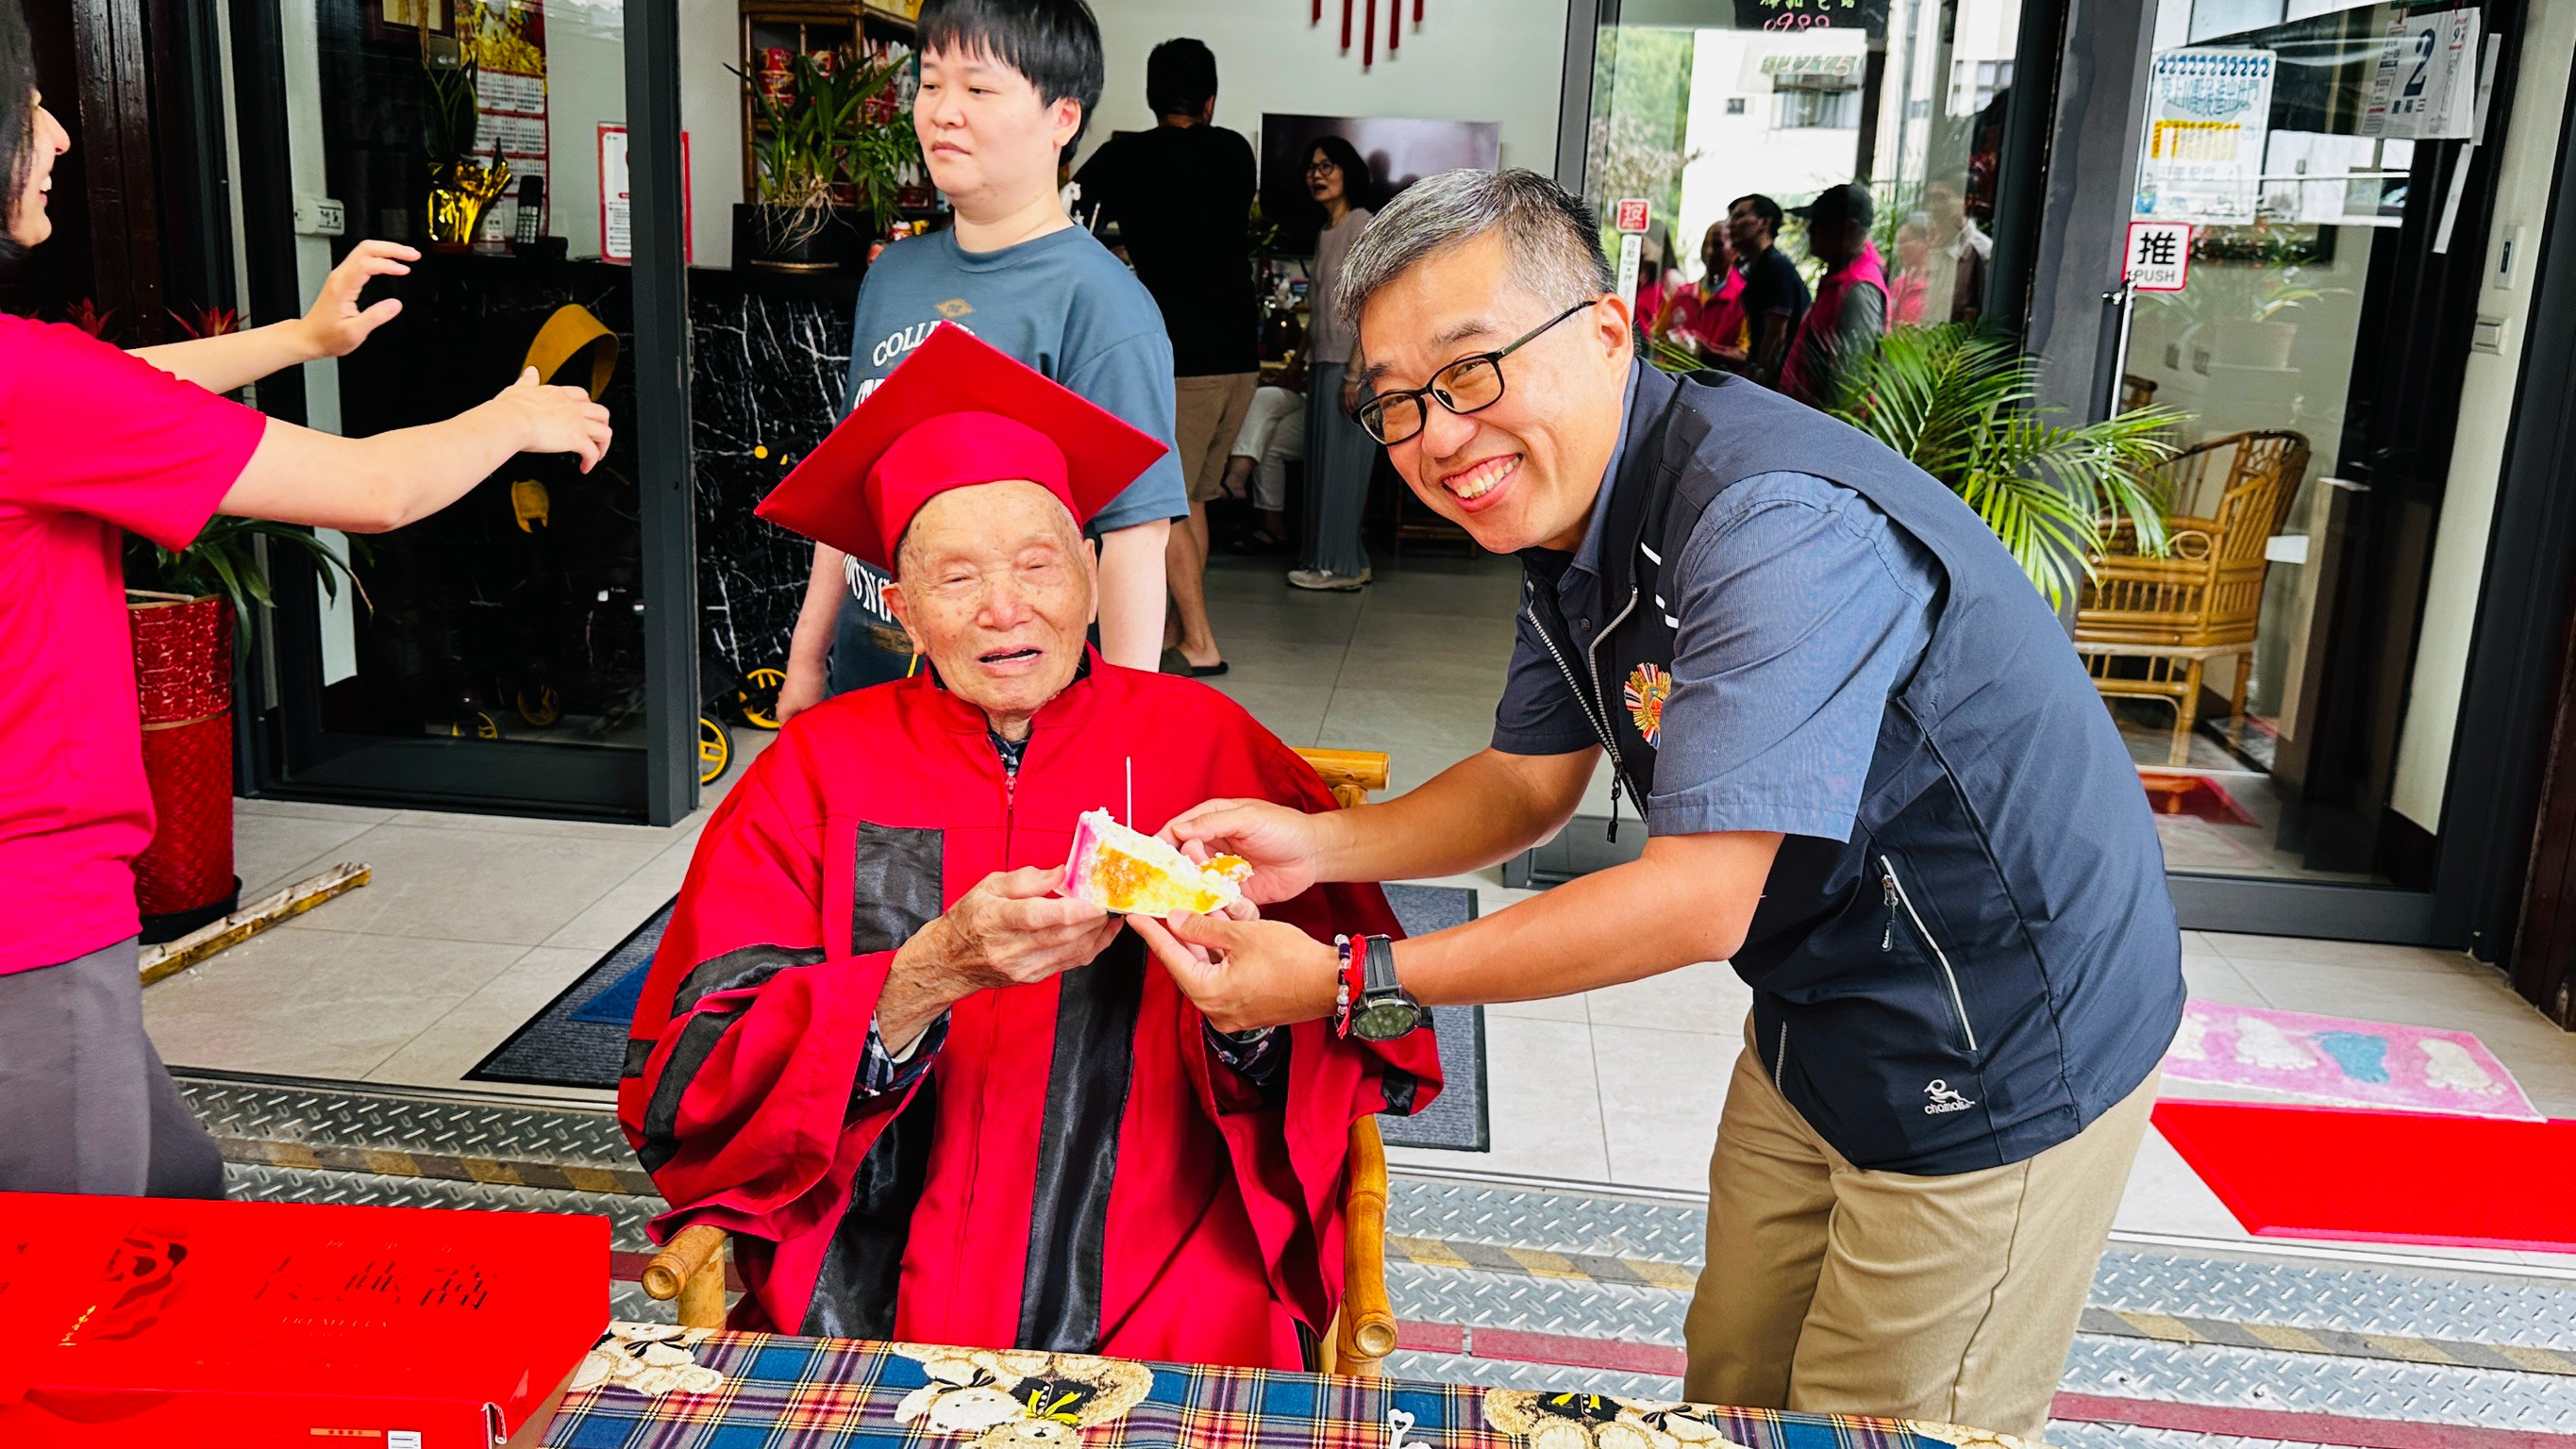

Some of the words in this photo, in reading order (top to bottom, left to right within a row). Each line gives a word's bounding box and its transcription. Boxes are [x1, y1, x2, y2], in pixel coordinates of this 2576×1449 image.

[2402, 27, 2436, 97] 2
[2137, 231, 2177, 265] 推
[2133, 269, 2176, 283] PUSH
